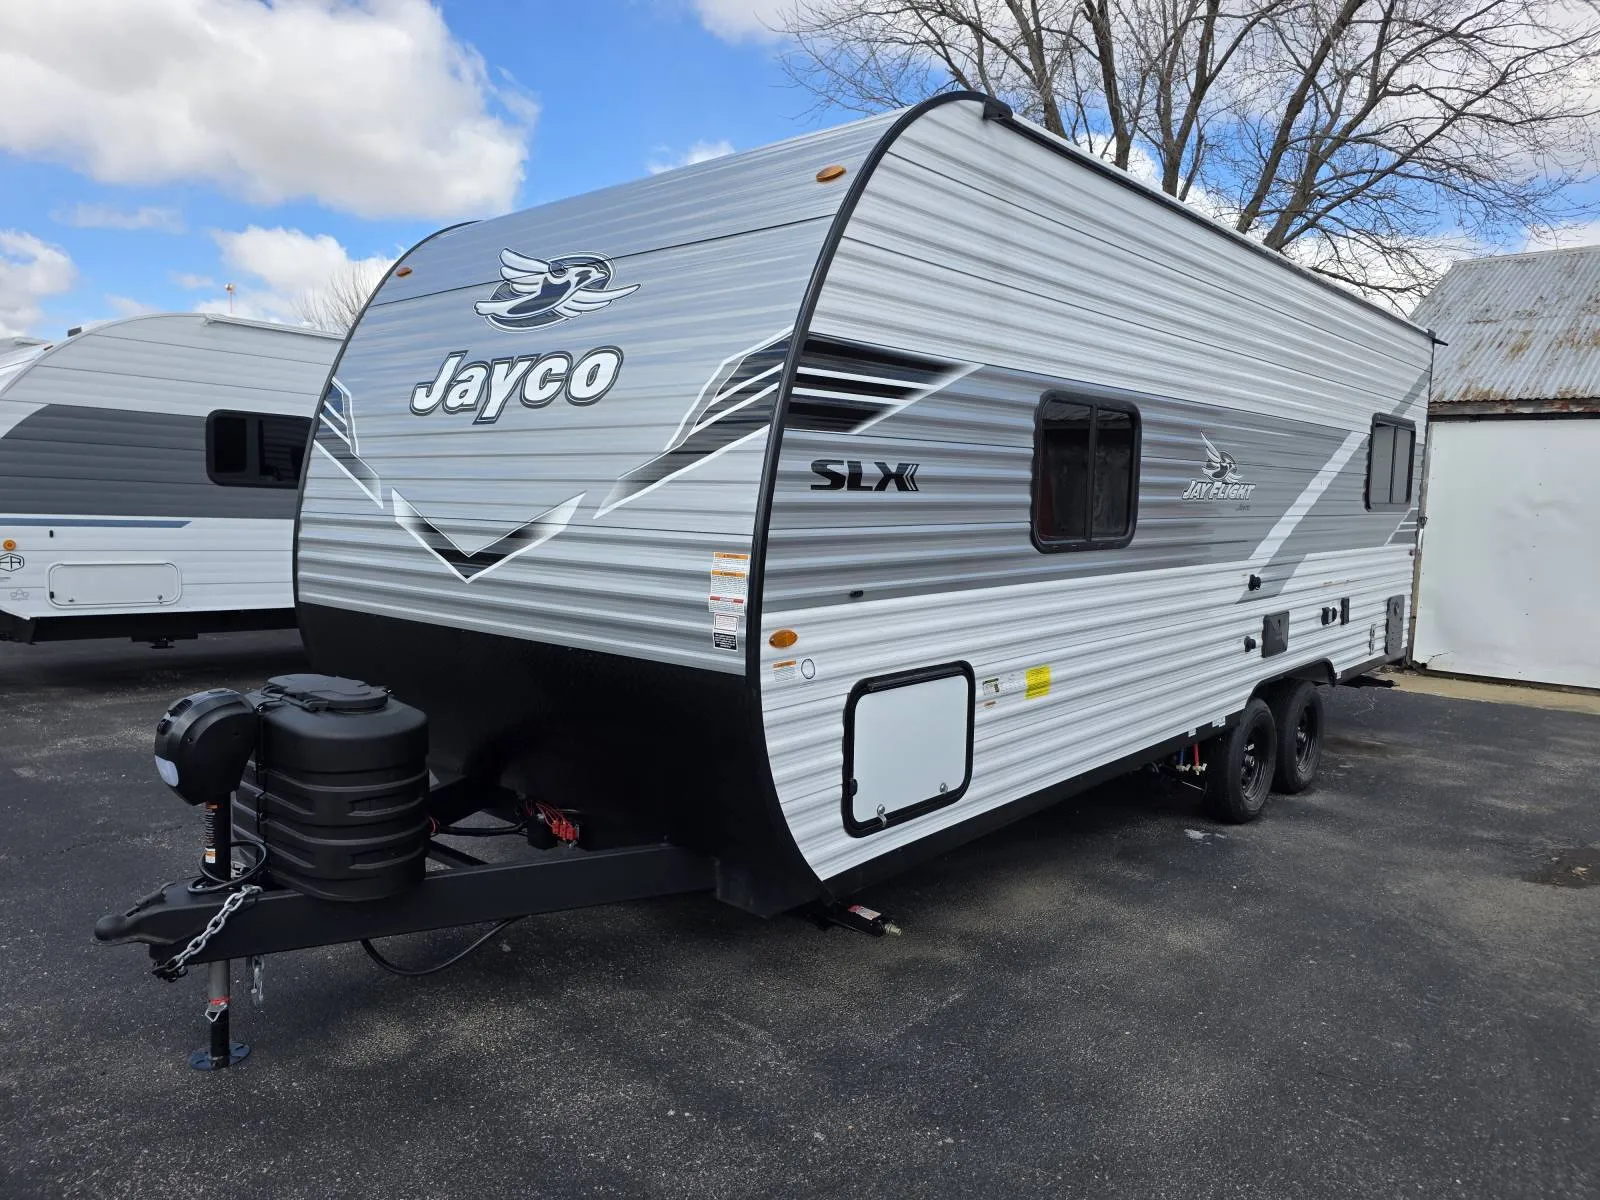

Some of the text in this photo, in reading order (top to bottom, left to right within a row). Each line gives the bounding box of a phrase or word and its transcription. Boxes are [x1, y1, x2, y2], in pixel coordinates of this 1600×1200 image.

[410, 346, 624, 424] Jayco
[811, 459, 920, 492] SLX
[1182, 480, 1257, 500] JAY FLIGHT
